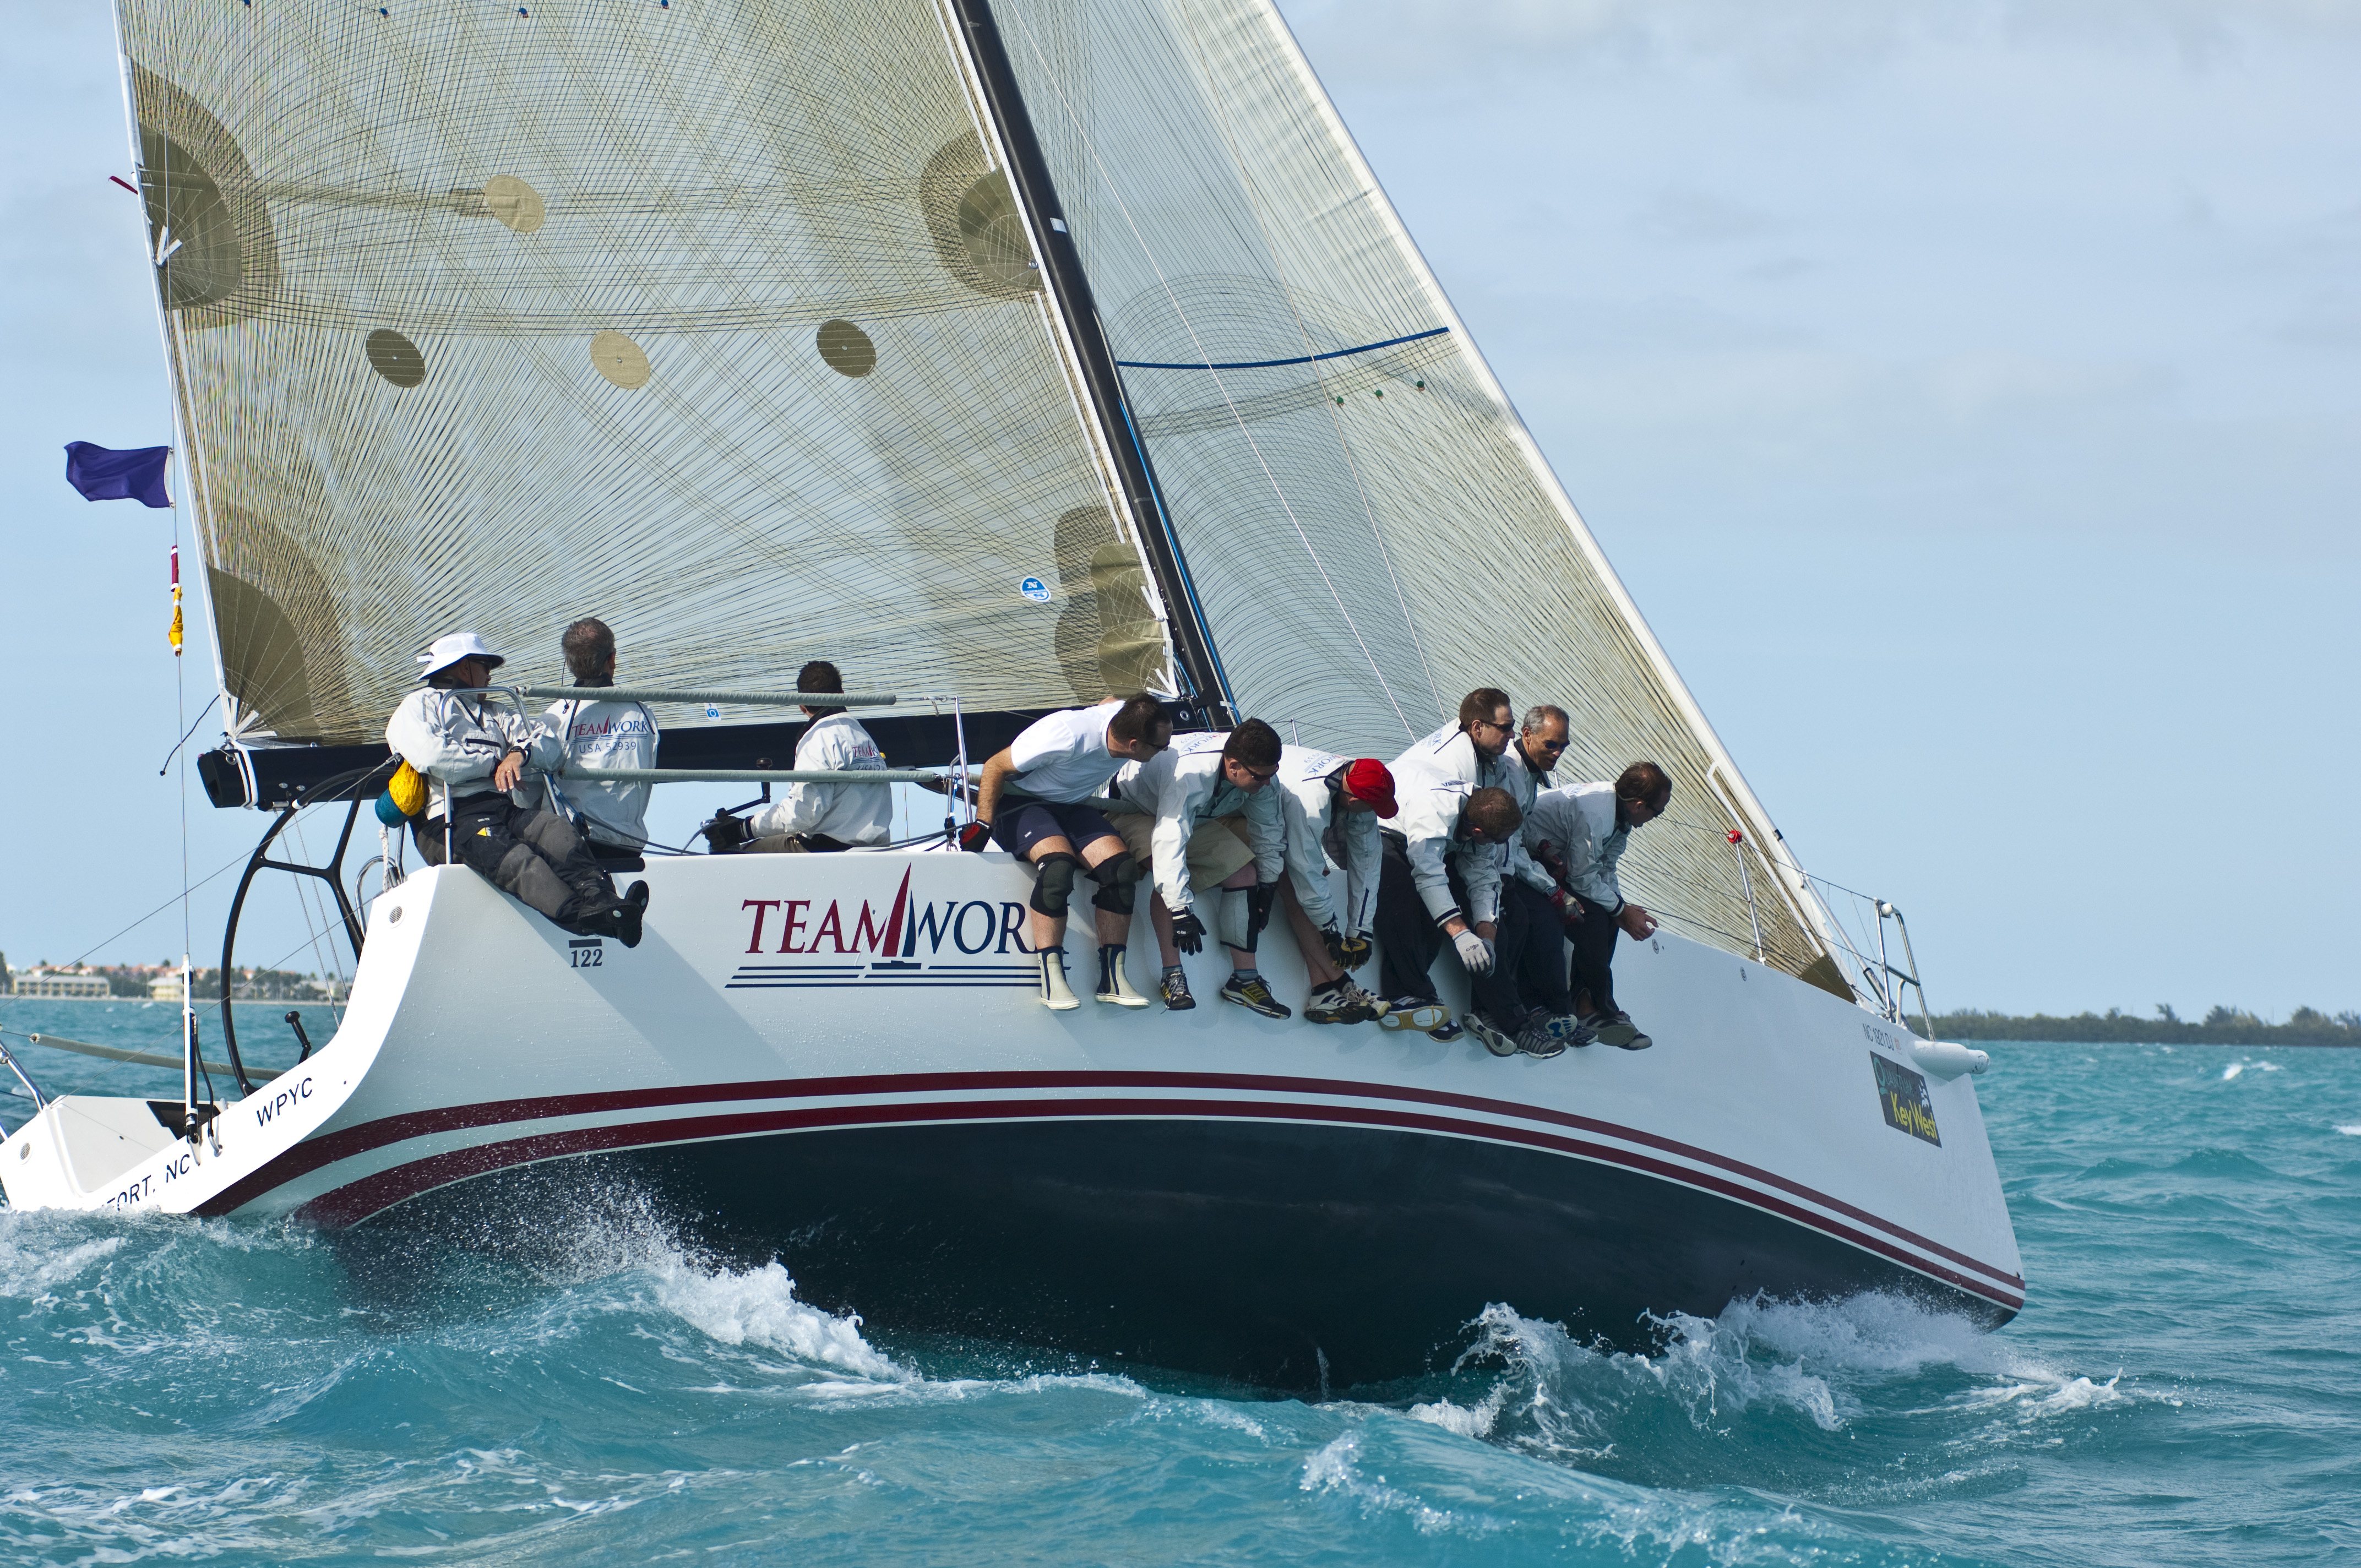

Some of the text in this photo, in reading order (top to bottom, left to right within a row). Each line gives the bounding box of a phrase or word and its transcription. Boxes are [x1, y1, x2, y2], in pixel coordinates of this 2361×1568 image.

[579, 742, 637, 754] USA 52939
[742, 890, 1069, 955] TEAMWOR
[571, 949, 603, 967] 122
[1862, 1023, 1873, 1042] NC
[1884, 1032, 1895, 1051] DJ
[1874, 1057, 1914, 1096] QUANTUM
[257, 1077, 313, 1127] WPYC
[1890, 1091, 1938, 1140] Key West
[166, 1153, 191, 1183] NC
